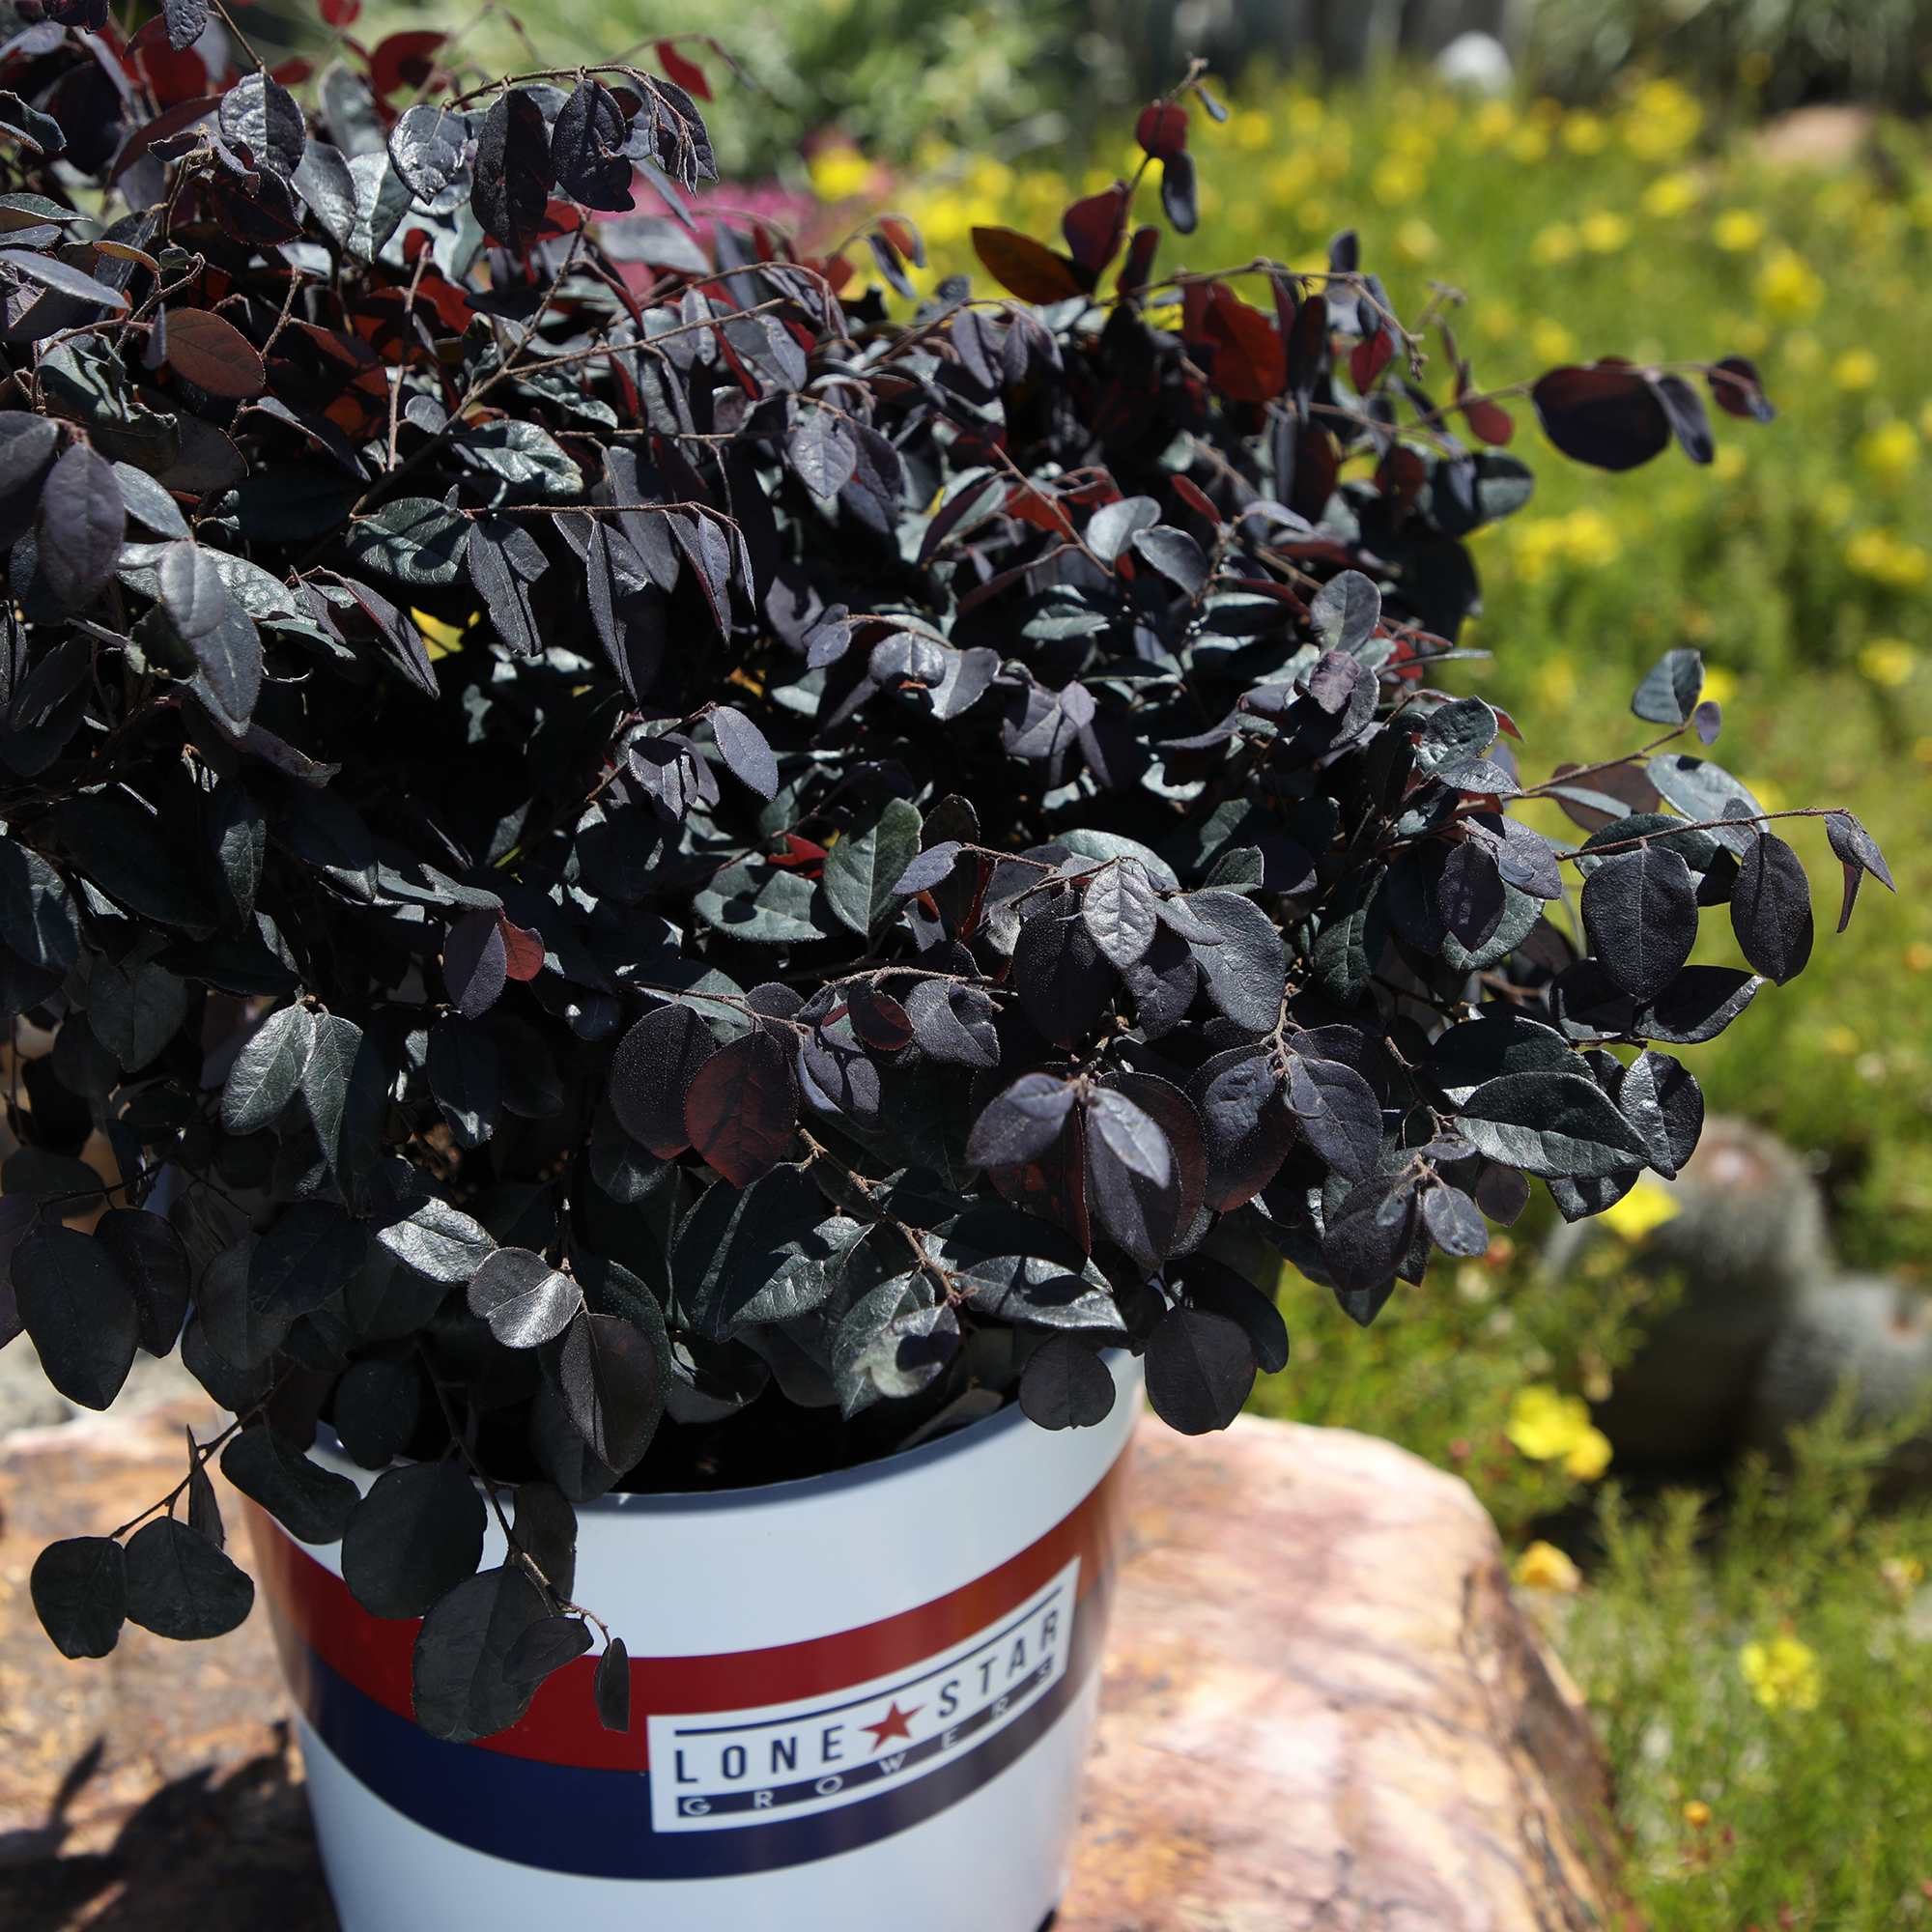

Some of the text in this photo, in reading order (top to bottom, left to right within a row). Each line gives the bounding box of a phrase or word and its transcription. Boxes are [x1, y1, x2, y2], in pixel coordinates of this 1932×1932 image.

[675, 1608, 1059, 1784] LONE STAR
[682, 1658, 1052, 1816] GROWERS
